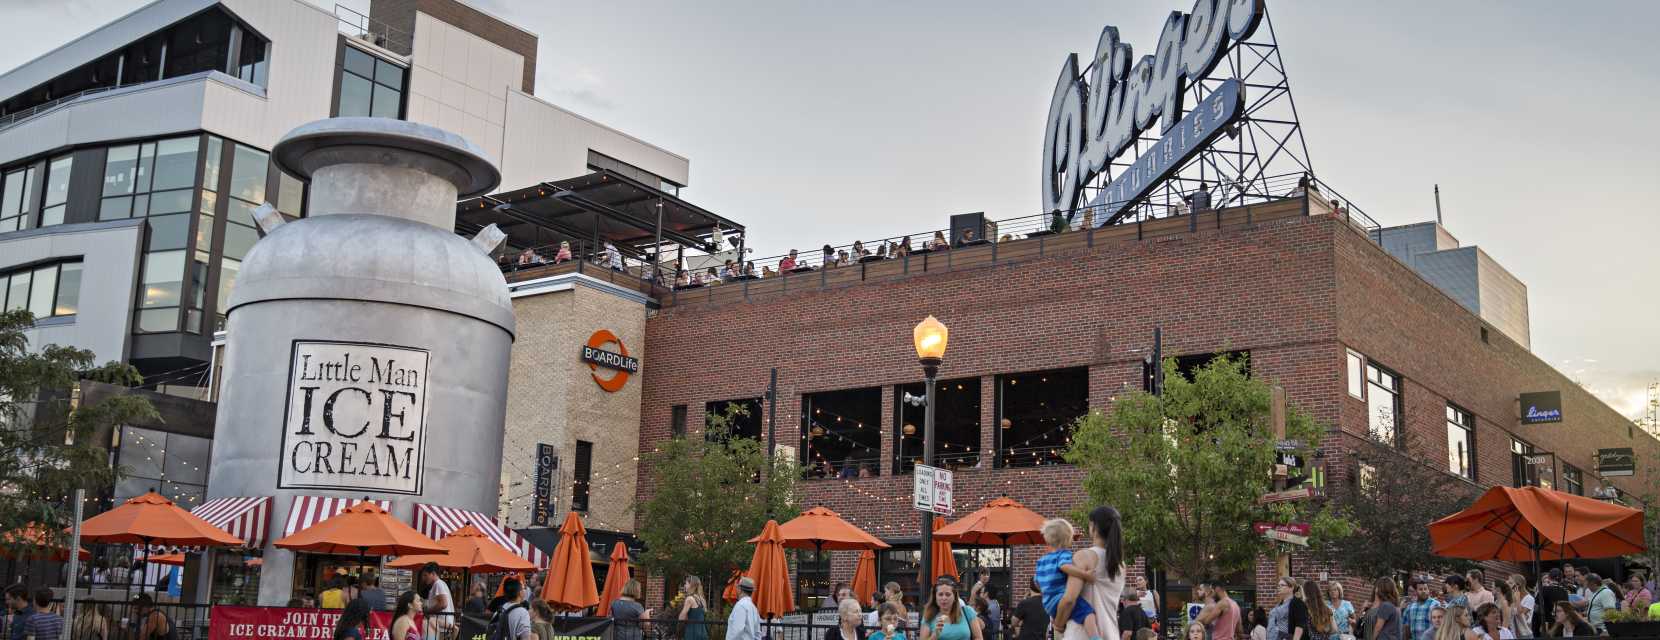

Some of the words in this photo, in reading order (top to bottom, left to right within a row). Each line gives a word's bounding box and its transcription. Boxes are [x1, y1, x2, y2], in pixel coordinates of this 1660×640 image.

[585, 347, 637, 371] BOARDLife
[300, 352, 361, 382] Little
[368, 356, 418, 388] Man
[295, 386, 417, 442] ICE
[291, 440, 414, 480] CREAM
[1527, 456, 1546, 465] 2030
[537, 445, 552, 524] BOARDLife
[939, 471, 947, 481] NO
[934, 481, 951, 492] PARKING
[283, 612, 321, 626] JOIN
[322, 613, 342, 626] TH
[229, 623, 253, 636] ICE
[257, 624, 310, 638] CREAM
